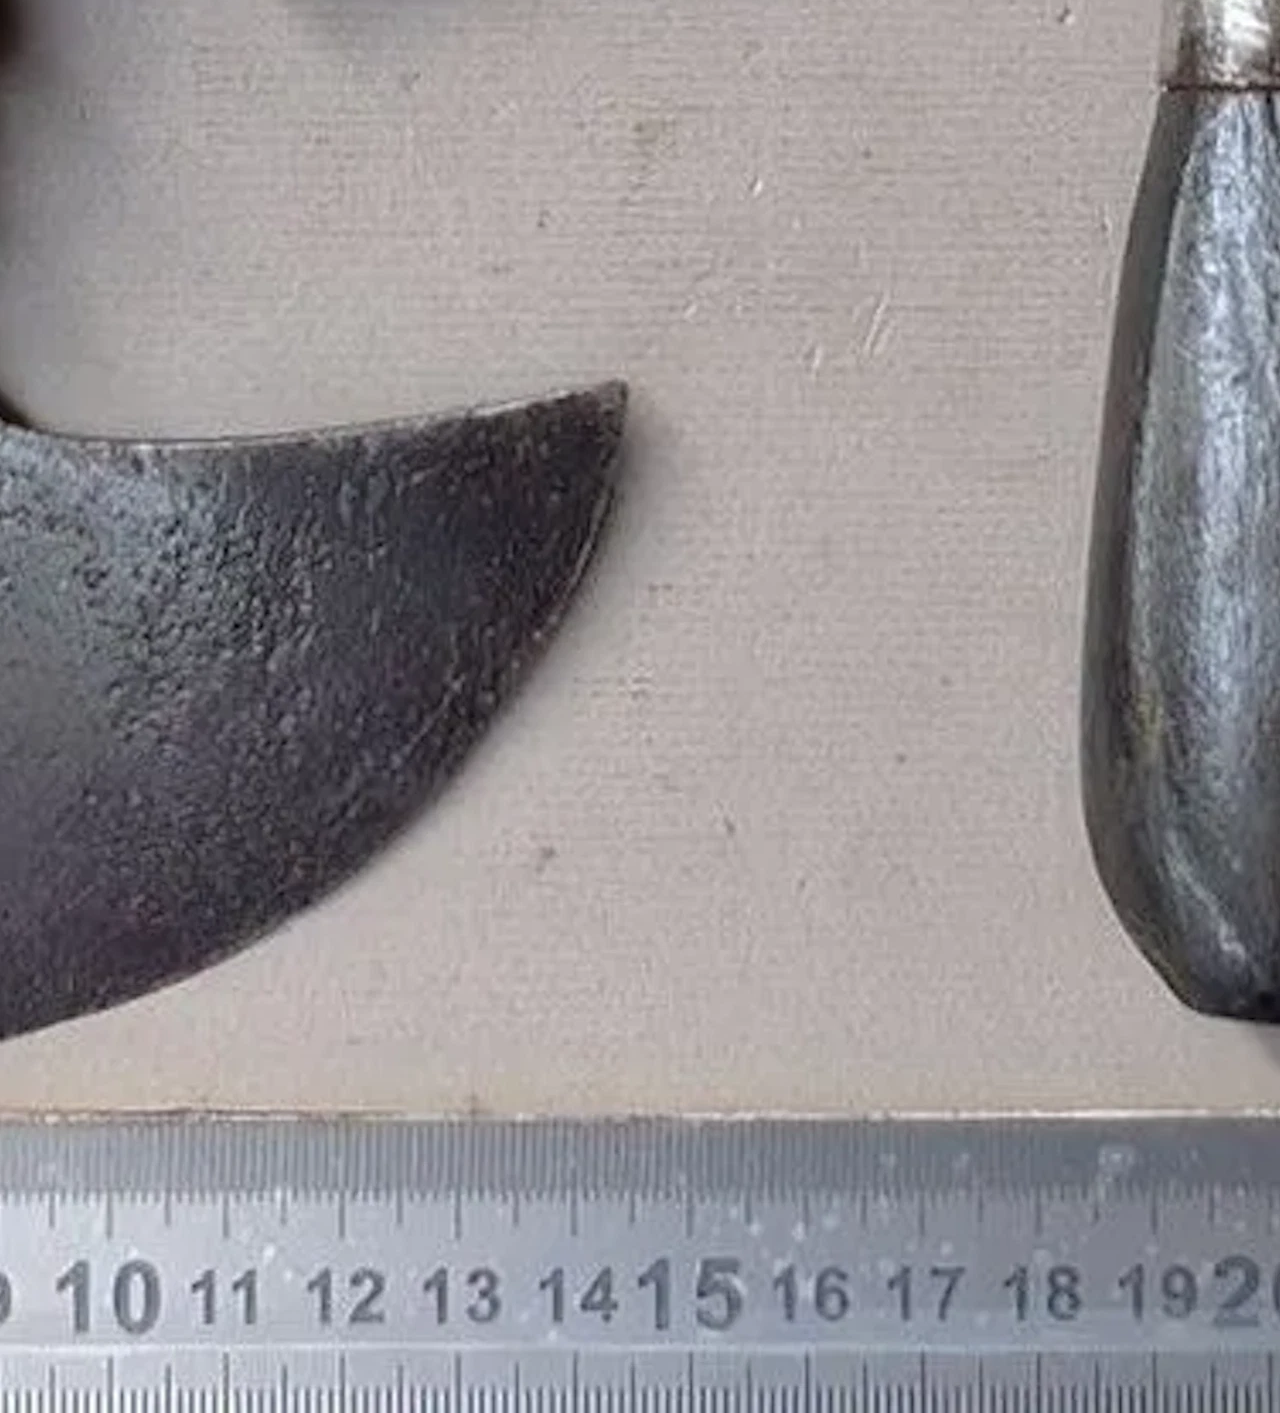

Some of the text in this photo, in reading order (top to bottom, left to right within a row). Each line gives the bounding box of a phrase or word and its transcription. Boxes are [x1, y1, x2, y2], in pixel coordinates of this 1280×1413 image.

[56, 1260, 160, 1336] 10
[191, 1268, 257, 1326] 11
[306, 1267, 385, 1327] 12
[423, 1267, 501, 1326] 13
[539, 1266, 618, 1325] 14
[637, 1258, 742, 1331] 15
[773, 1265, 850, 1323] 16
[887, 1266, 965, 1321] 17
[1003, 1266, 1082, 1321] 18
[1118, 1264, 1197, 1320] 19
